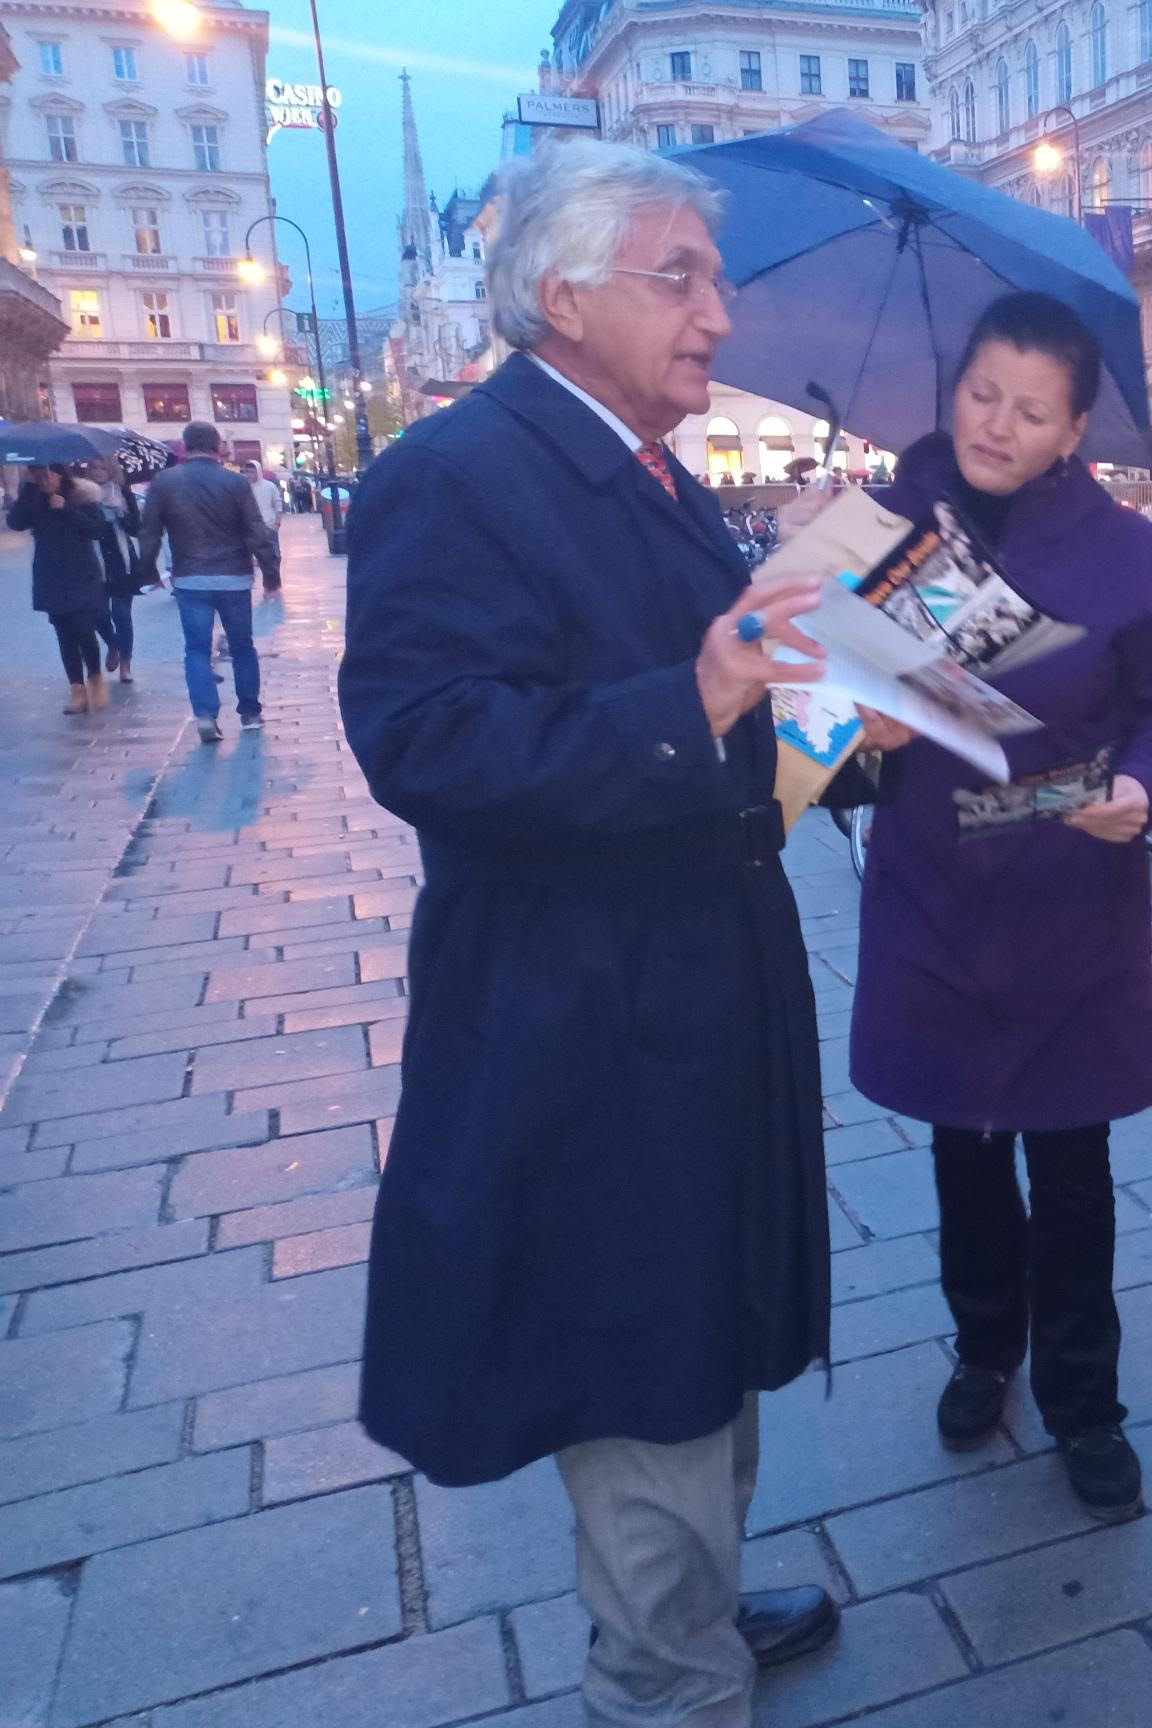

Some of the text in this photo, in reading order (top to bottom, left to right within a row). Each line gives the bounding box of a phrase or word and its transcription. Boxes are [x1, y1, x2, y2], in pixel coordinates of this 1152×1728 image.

[266, 79, 342, 108] CASINO
[269, 105, 314, 124] WIEN
[527, 101, 590, 113] PALMERS
